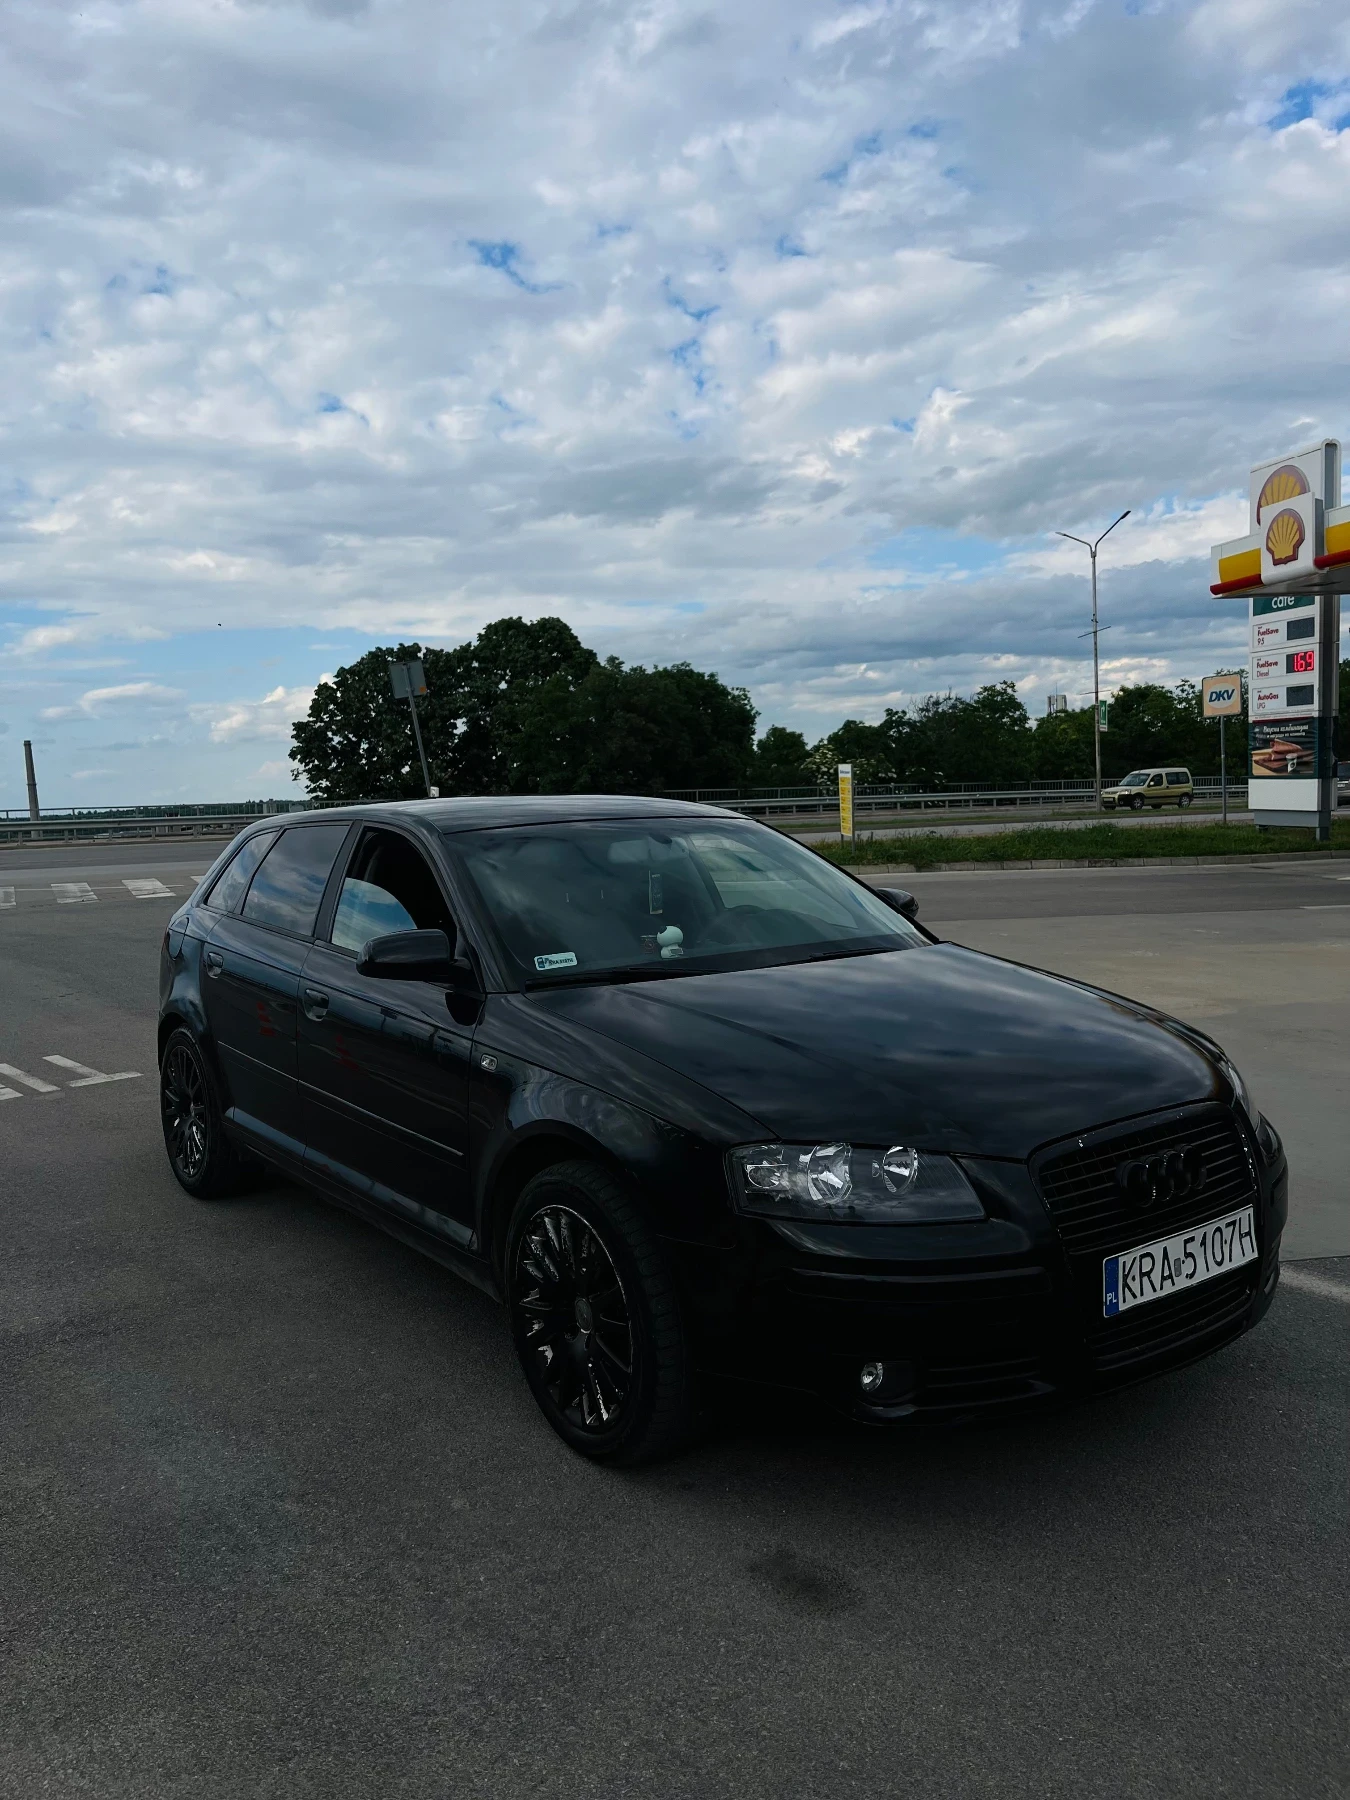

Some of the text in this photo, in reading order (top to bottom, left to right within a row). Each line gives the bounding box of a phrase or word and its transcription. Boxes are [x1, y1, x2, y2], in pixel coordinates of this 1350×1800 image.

[1257, 628, 1279, 637] FuelSave
[1257, 637, 1265, 646] 95
[1256, 660, 1279, 669] FuelSave
[1256, 668, 1270, 678] Diesel
[1208, 688, 1235, 702] DKV
[1257, 692, 1279, 701] AutoGas
[1256, 702, 1266, 710] LPG
[1122, 1213, 1254, 1304] KRA 5107H
[1106, 1292, 1117, 1305] PL
